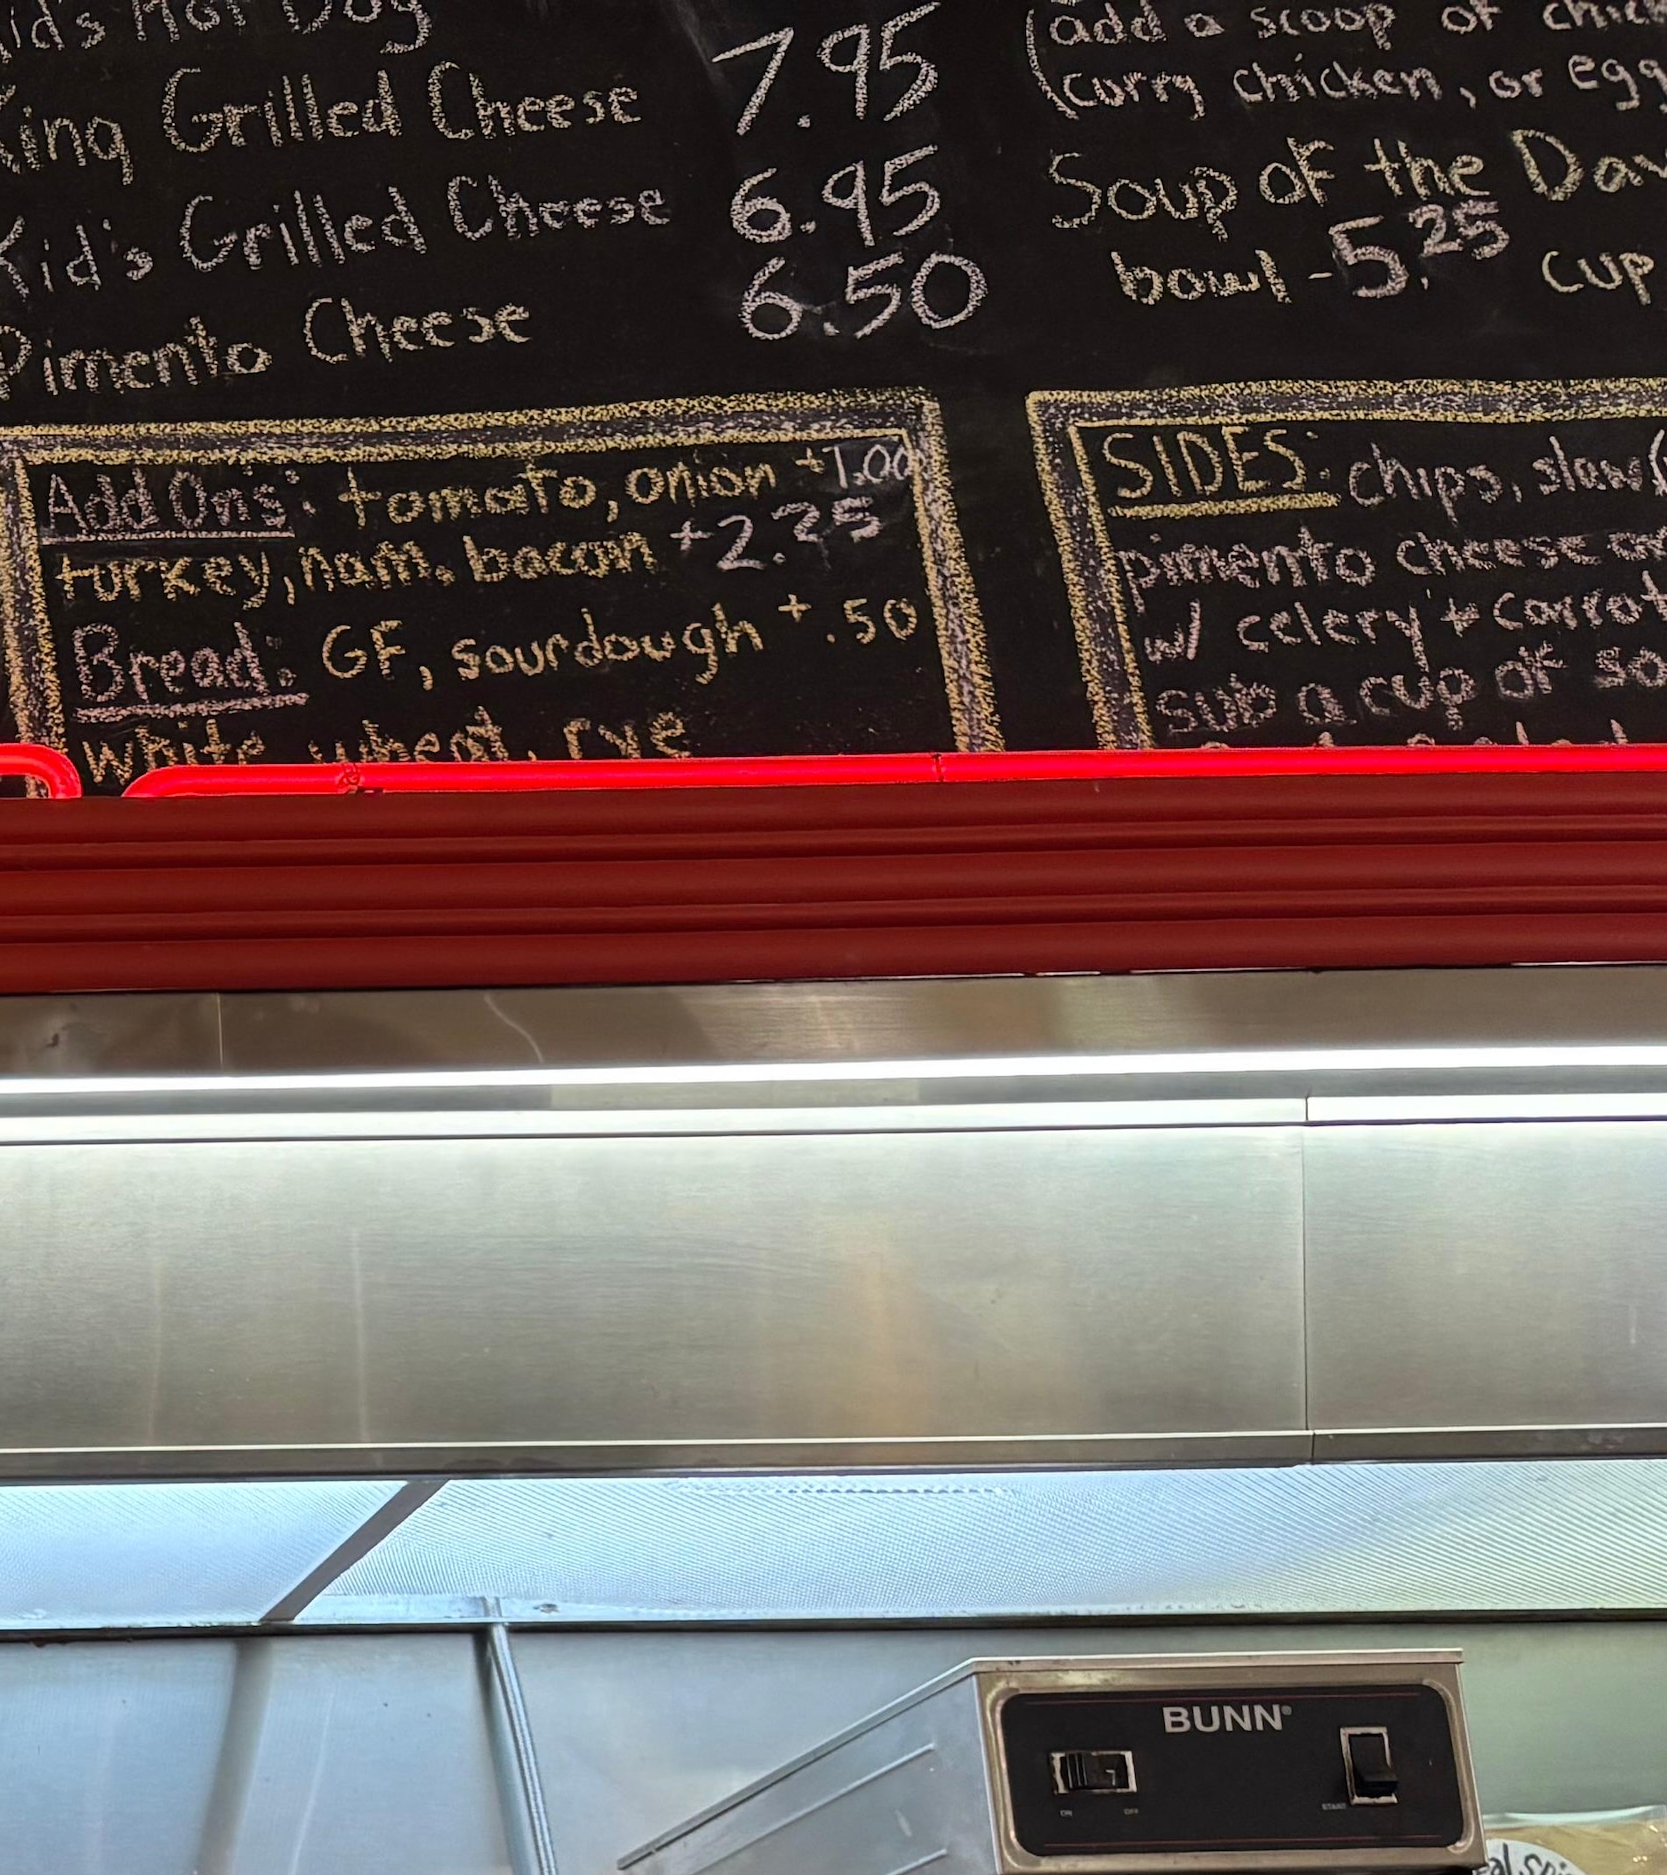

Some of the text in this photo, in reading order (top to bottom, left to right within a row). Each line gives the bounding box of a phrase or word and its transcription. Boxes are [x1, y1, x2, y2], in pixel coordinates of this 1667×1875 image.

[1250, 2, 1394, 50] scoop
[163, 68, 402, 153] Grilled
[427, 61, 642, 139] Cheese
[712, 2, 942, 135] 7.95
[1488, 67, 1543, 98] or
[178, 188, 427, 272] Grilled
[446, 175, 671, 241] Cheese
[730, 145, 942, 247] 6.95
[1048, 135, 1491, 241] Soup of the
[302, 296, 533, 364] Cheese
[739, 252, 988, 341] 6.50
[1110, 249, 1292, 303] bowl
[1542, 250, 1655, 305] cup
[47, 466, 159, 535] Add
[624, 449, 776, 505] onion
[463, 534, 658, 584] bacon
[1115, 526, 1377, 616] pimento
[1394, 531, 1603, 576] cheese
[450, 602, 764, 684] sourdough
[1238, 601, 1430, 672] celery
[1358, 664, 1478, 732] cup
[1161, 1703, 1284, 1734] BUNN
